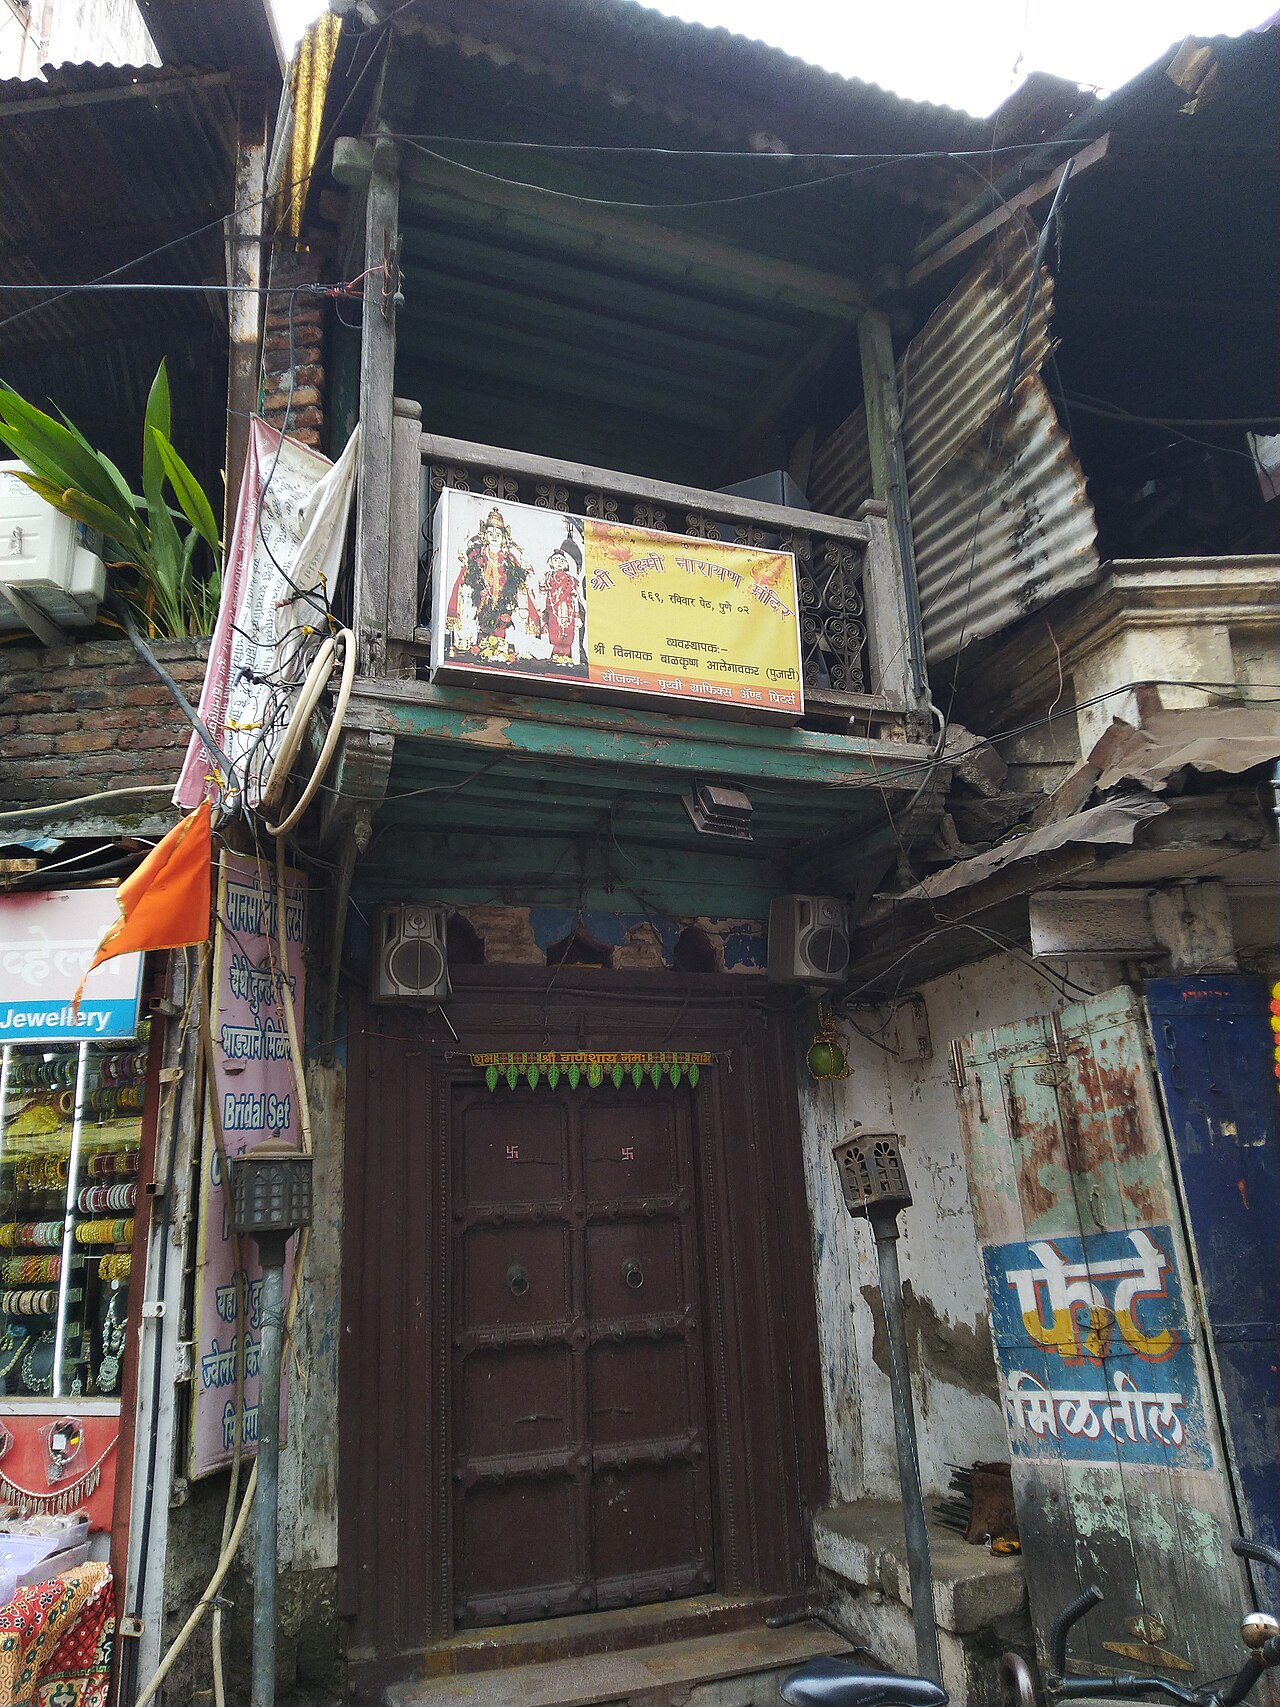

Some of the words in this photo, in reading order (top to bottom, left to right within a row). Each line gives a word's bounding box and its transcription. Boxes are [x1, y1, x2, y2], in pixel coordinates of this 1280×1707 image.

[589, 568, 616, 591] श्री
[617, 551, 665, 579] लक्ष्मी
[674, 557, 744, 589] नारायण
[751, 581, 796, 623] मंदिर
[641, 591, 664, 604] ६६९,
[668, 593, 696, 608] रविवार
[699, 596, 715, 612] पेठ,
[719, 600, 733, 615] पुणे
[593, 642, 606, 656] श्री
[613, 644, 653, 662] विनायक
[659, 653, 699, 670] बाळकृष्ण
[706, 658, 760, 676] आलेगावकर
[765, 667, 800, 683] (पुजारी)
[658, 678, 683, 693] पृथ्वी
[689, 681, 733, 698] ग्राफिक्स
[768, 689, 796, 706] प्रिंटर्स
[0, 1007, 112, 1032] Jewellery
[223, 1092, 267, 1130] Bridal
[267, 1093, 291, 1130] Set
[1006, 1228, 1181, 1365] फेटे
[1007, 1371, 1187, 1448] मिळतील
